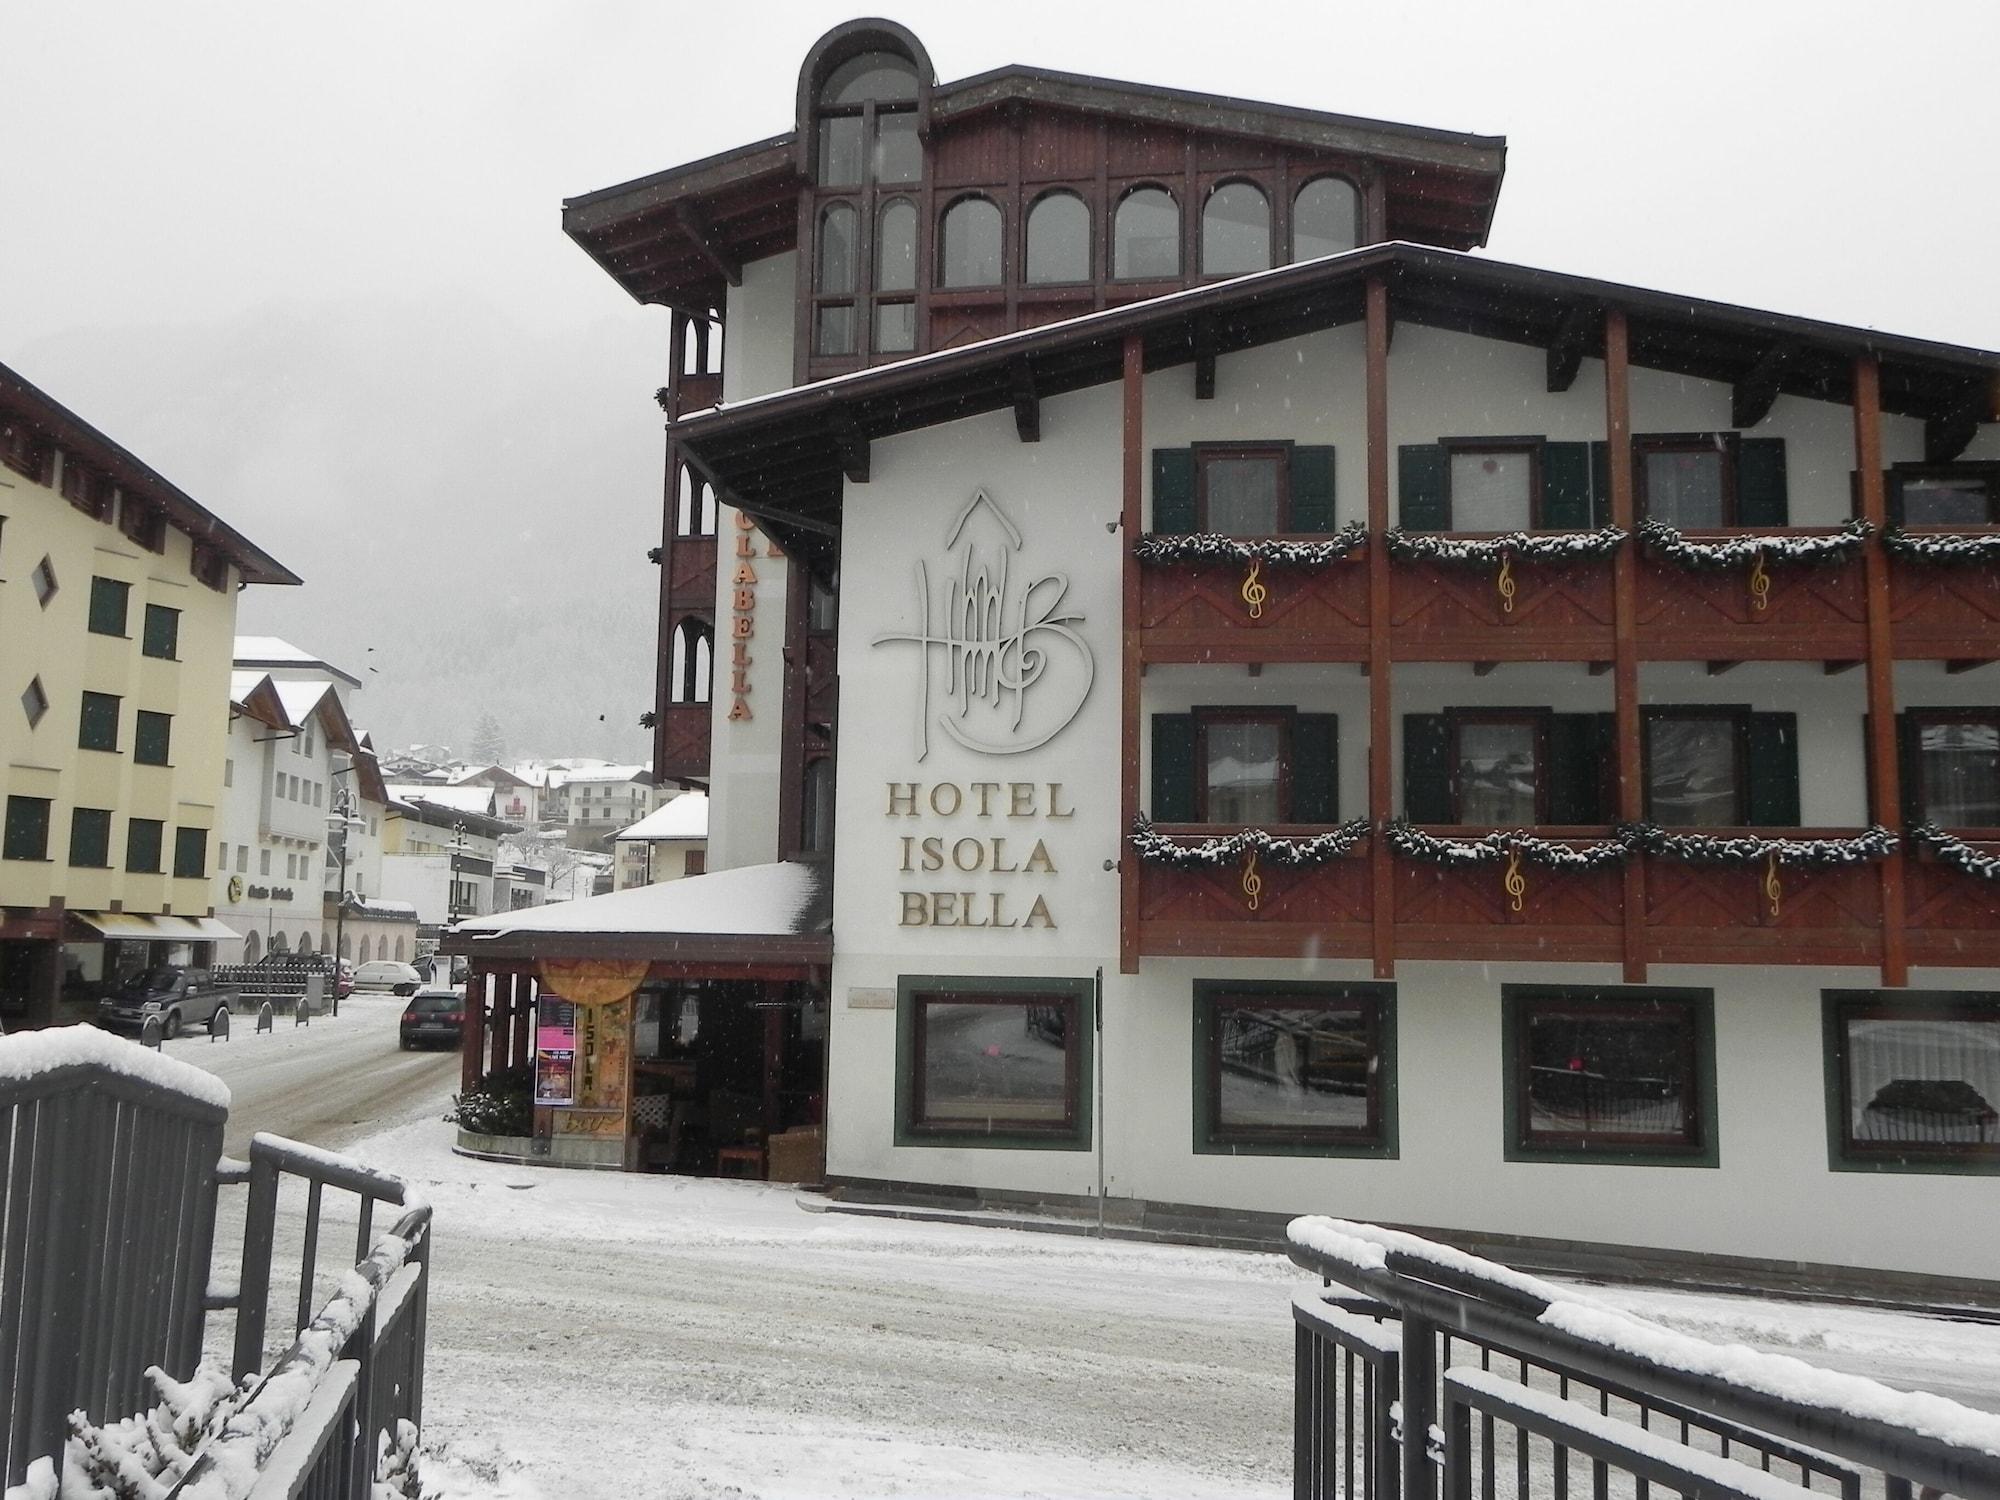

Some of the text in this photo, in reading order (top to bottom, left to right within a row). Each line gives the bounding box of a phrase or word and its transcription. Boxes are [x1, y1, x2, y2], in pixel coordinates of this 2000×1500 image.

[885, 782, 1075, 817] HOTEL
[899, 836, 1058, 872] ISOLA
[898, 891, 1058, 929] BELLA
